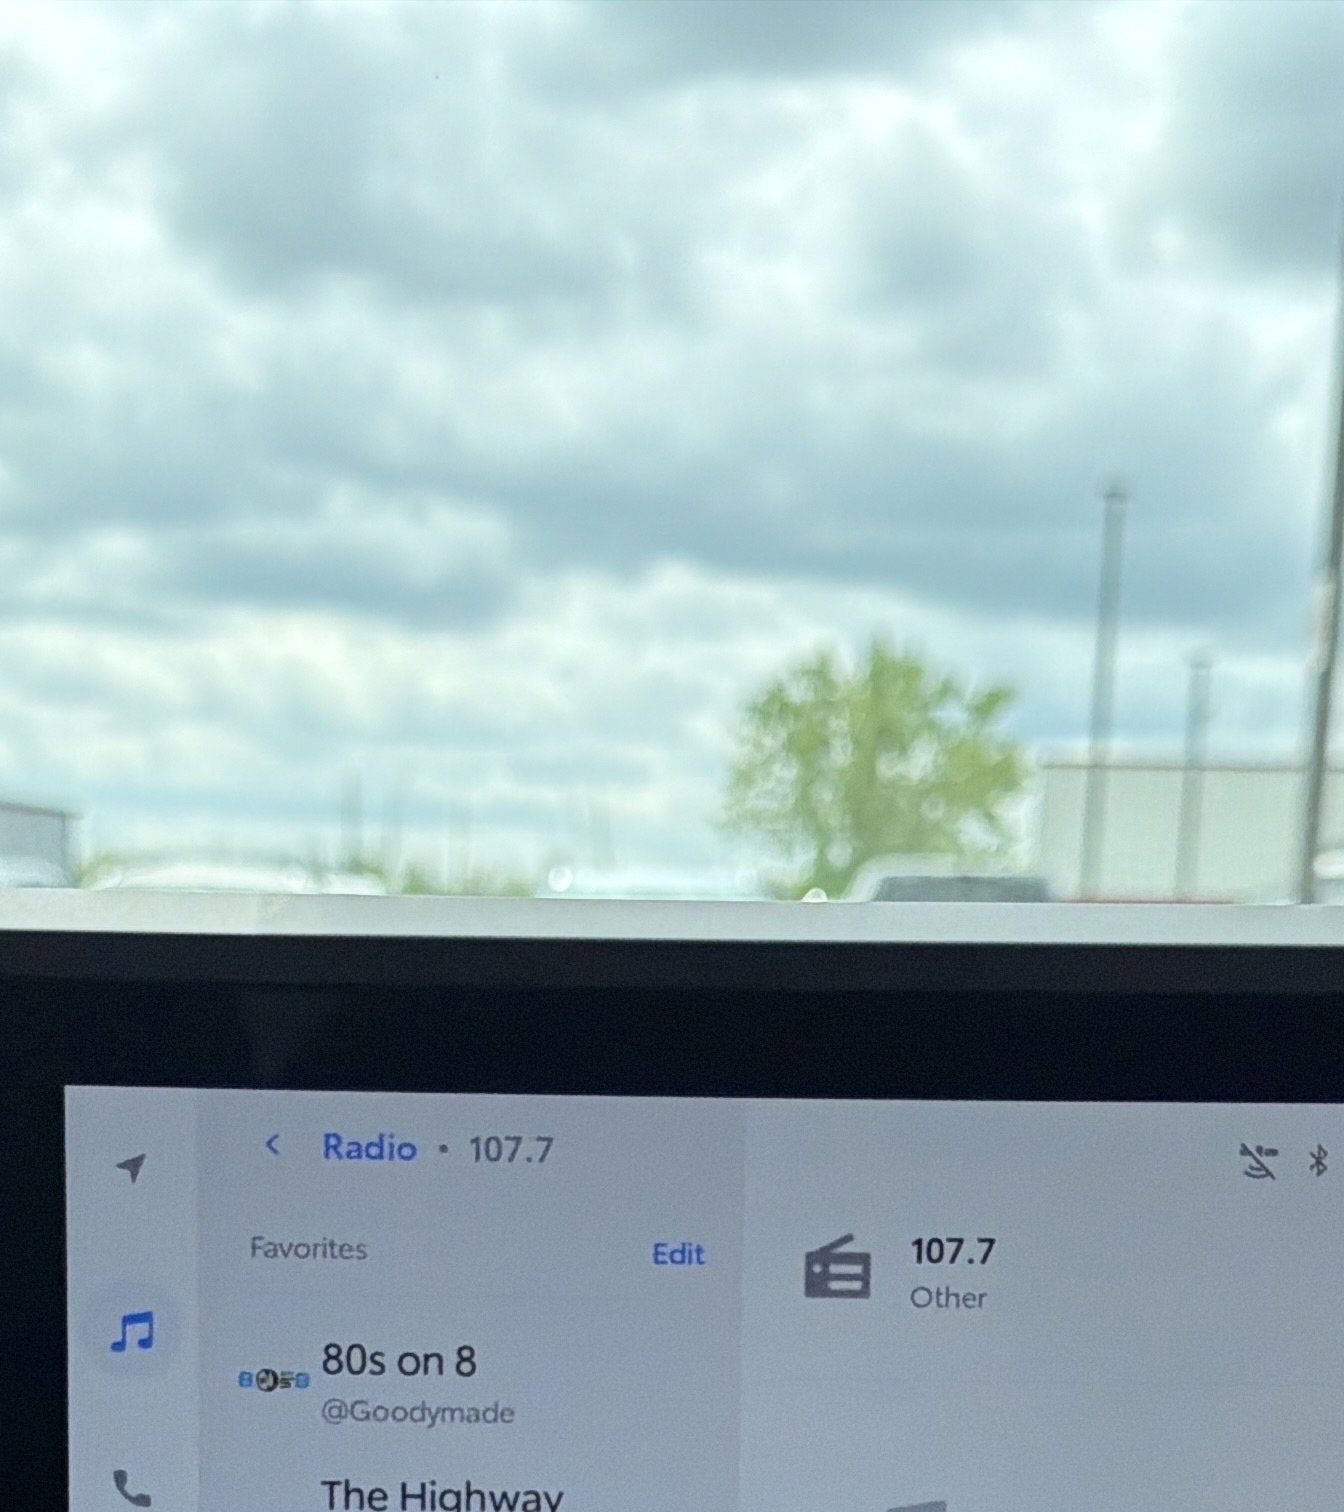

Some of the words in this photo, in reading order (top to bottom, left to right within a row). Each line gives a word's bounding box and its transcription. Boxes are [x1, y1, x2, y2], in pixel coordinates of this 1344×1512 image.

[323, 1133, 417, 1162] Radio
[469, 1136, 554, 1164] 107.7
[250, 1235, 368, 1260] Favorites
[652, 1242, 705, 1266] Edit
[910, 1237, 996, 1265] 107.7
[910, 1285, 987, 1310] Other
[322, 1343, 386, 1376] 80s
[398, 1350, 444, 1376] on
[454, 1345, 477, 1377] 8
[321, 1400, 515, 1429] @Goodymade
[322, 1481, 388, 1511] The
